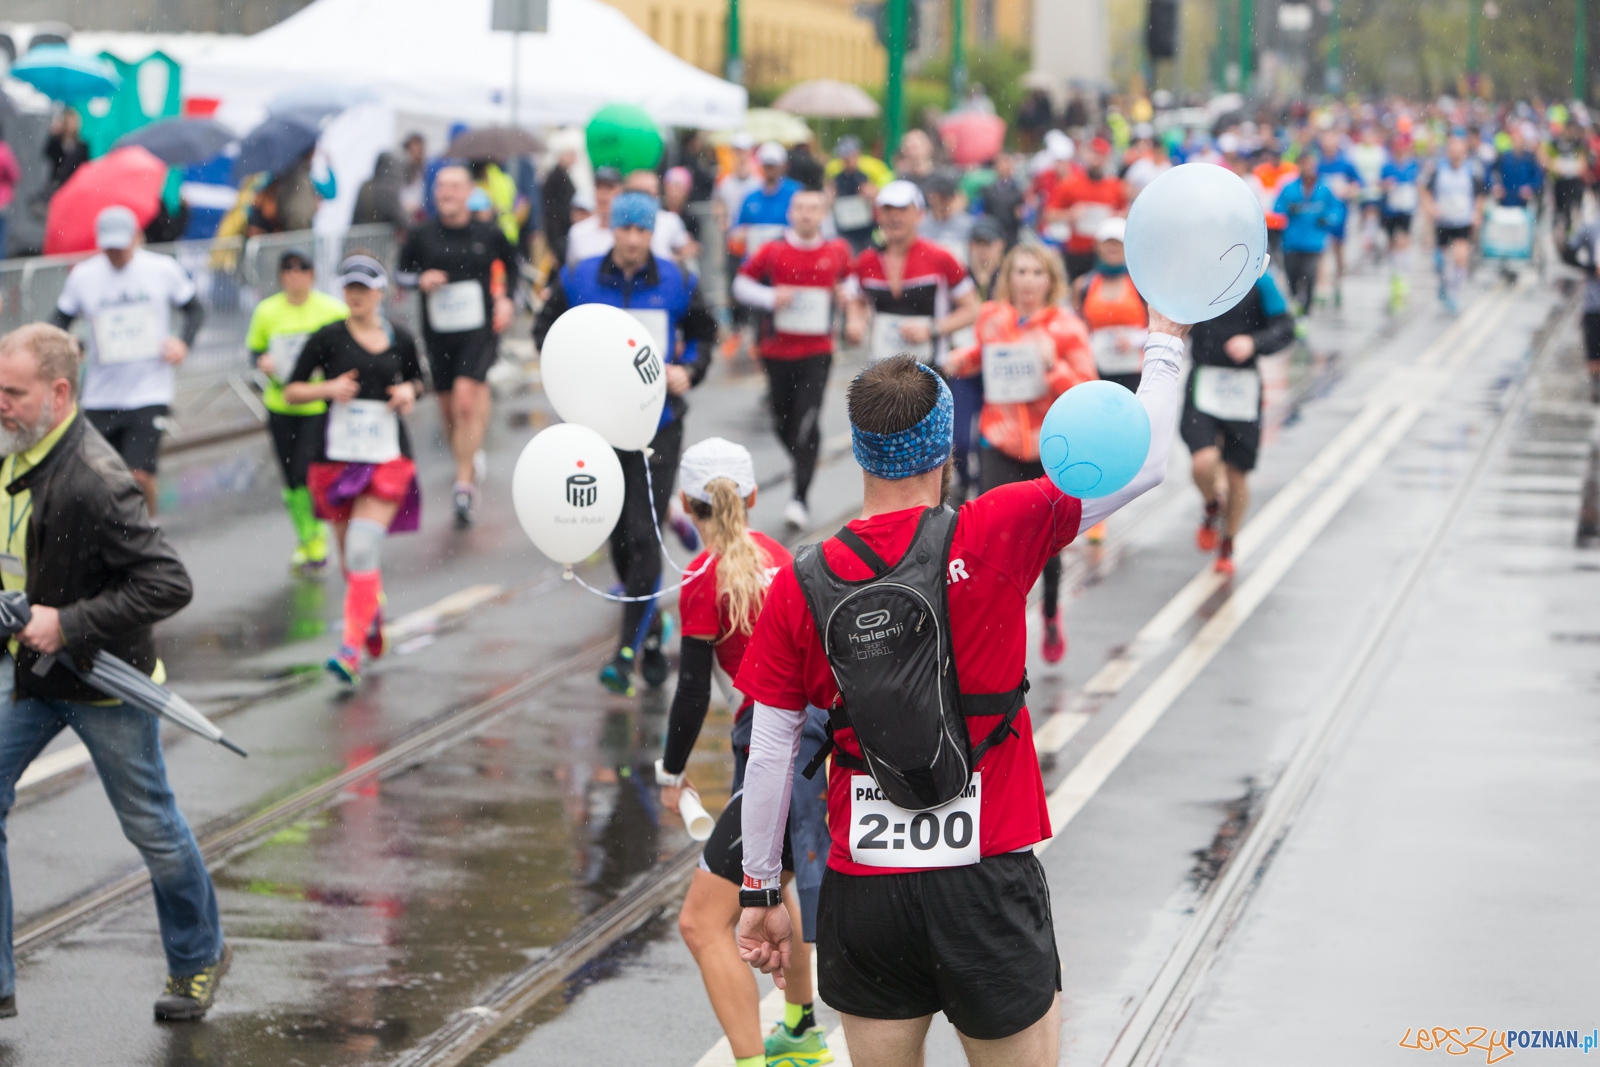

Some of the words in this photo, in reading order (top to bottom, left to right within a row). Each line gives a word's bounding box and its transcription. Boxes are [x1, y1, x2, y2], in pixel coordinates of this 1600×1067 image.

[848, 622, 904, 643] Kalenji
[856, 787, 888, 801] PAC
[857, 811, 973, 850] 2:00
